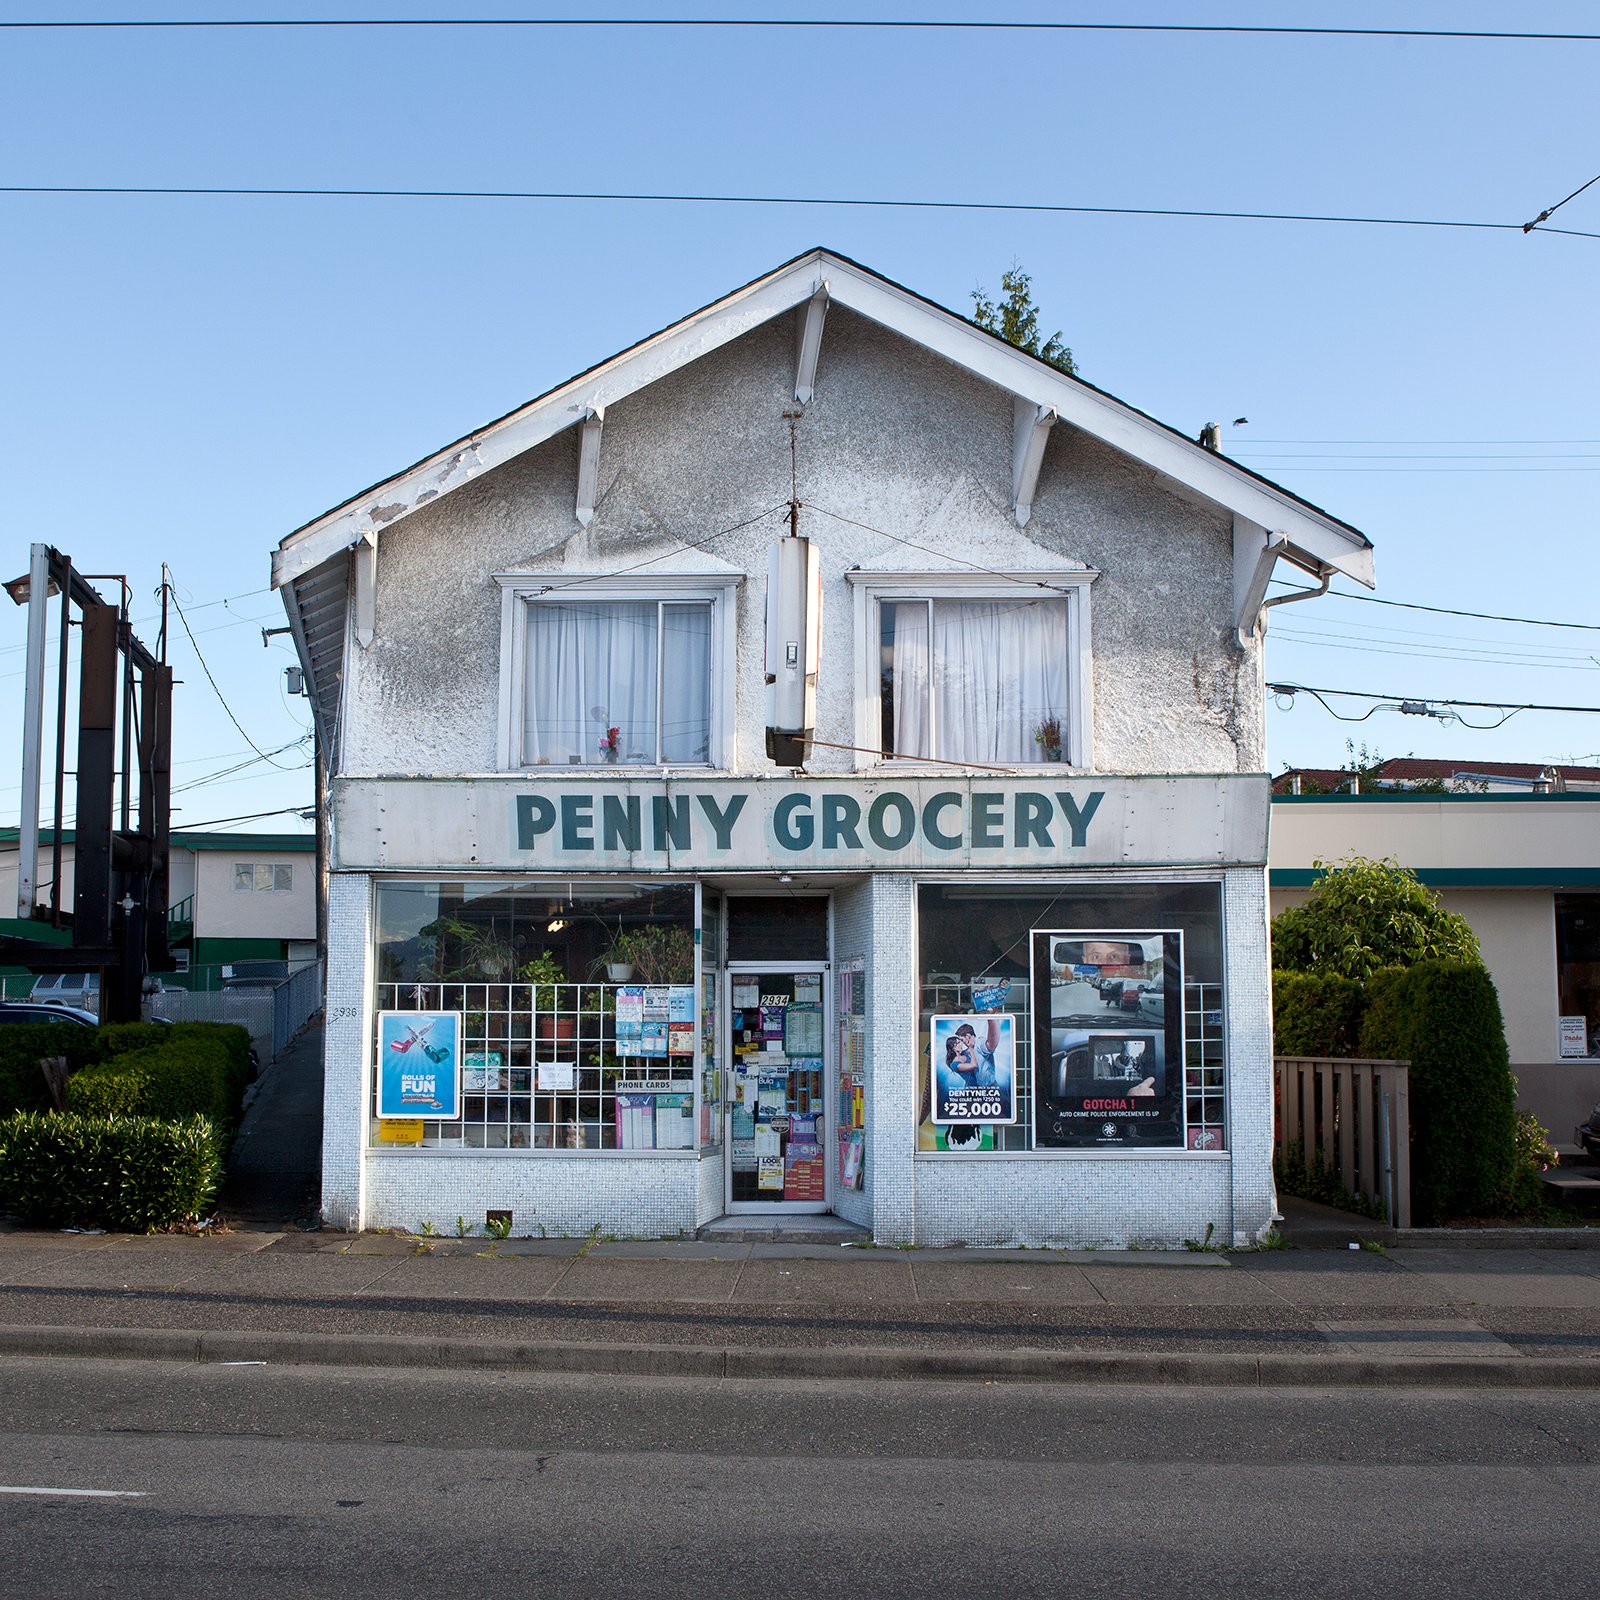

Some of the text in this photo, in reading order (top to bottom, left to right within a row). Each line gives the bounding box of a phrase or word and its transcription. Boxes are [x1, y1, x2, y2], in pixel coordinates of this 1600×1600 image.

[516, 791, 1105, 851] PENNY GROCERY
[762, 995, 788, 1006] 2934
[333, 1007, 358, 1017] 2936
[402, 1080, 435, 1093] FUN
[944, 1102, 1002, 1118] $25,000
[1083, 1099, 1135, 1110] GOTCHA !
